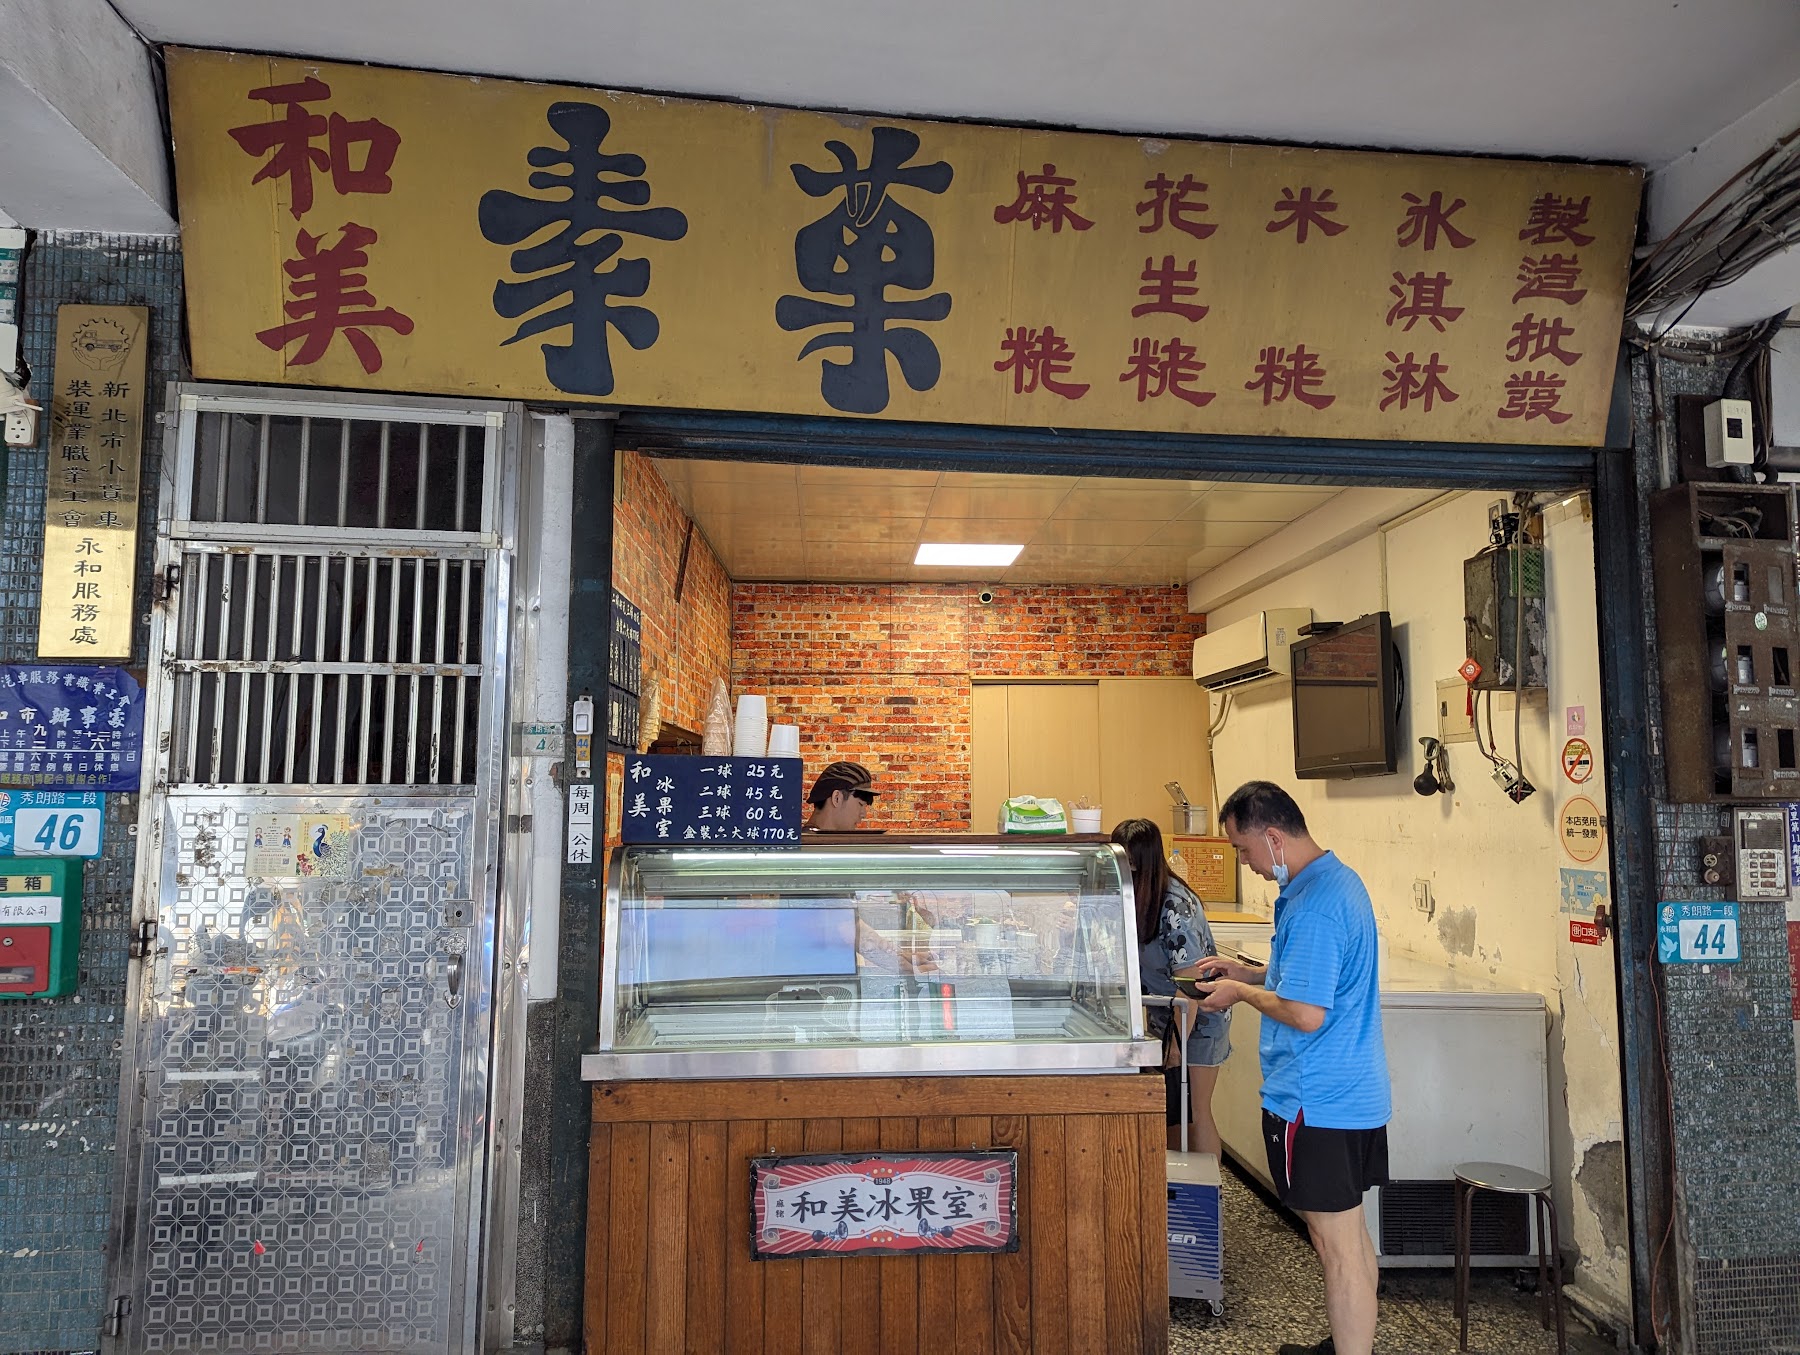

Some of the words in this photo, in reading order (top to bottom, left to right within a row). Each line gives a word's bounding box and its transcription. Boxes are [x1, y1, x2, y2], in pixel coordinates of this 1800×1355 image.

[227, 76, 414, 375] 和美
[1380, 191, 1476, 413] 冰淇淋
[1498, 192, 1596, 424] 製造批發
[59, 380, 94, 527] 裝運業職業工會
[96, 381, 130, 527] 新北市小貨車
[70, 537, 103, 645] 永和服務處
[628, 761, 652, 818] 和美
[700, 763, 733, 779] 一球
[746, 764, 784, 779] 25元
[20, 791, 97, 805] 秀朗路一段
[656, 776, 675, 838] 冰果室
[699, 784, 732, 799] 二球
[745, 785, 783, 800] 45元
[570, 786, 593, 862] 每周一公休
[697, 805, 731, 819] 三球
[745, 806, 782, 821] 60元
[1566, 816, 1597, 826] 本店免用
[34, 814, 84, 850] 46
[1566, 828, 1598, 839] 統一發票
[1660, 925, 1678, 933] 永和區
[1681, 905, 1733, 917] 秀朗路一段
[1694, 924, 1726, 955] 44
[791, 1185, 975, 1223] 和美冰果室
